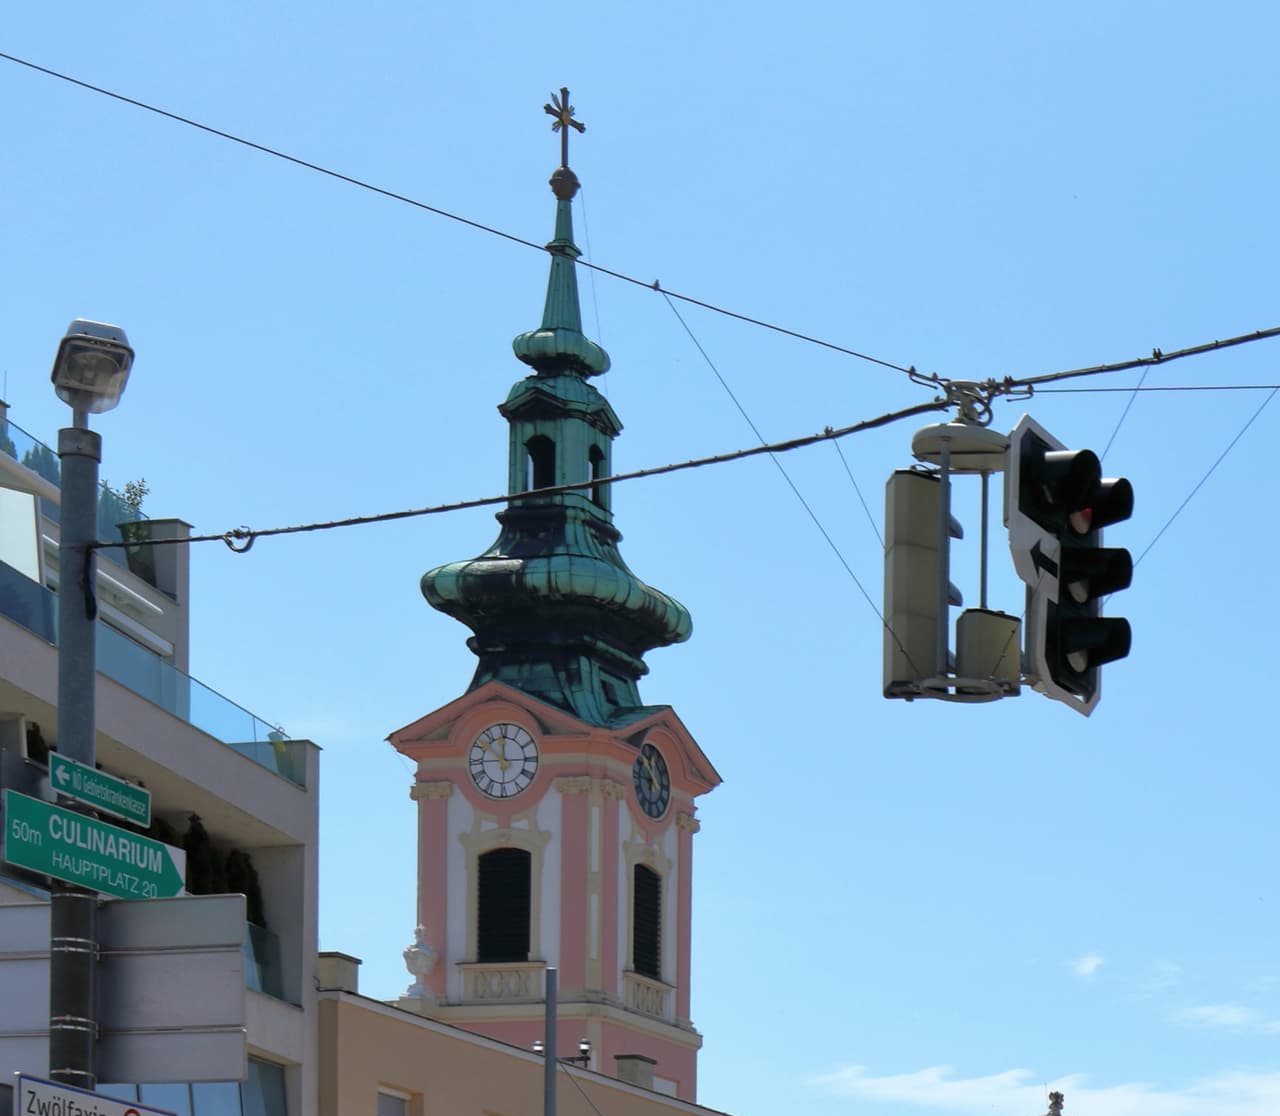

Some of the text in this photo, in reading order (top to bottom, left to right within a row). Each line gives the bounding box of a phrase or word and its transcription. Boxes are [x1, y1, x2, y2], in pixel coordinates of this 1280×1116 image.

[12, 819, 42, 846] 50m
[49, 814, 162, 874] CULINARIUM
[52, 851, 157, 898] HAUPTPLATZ 20
